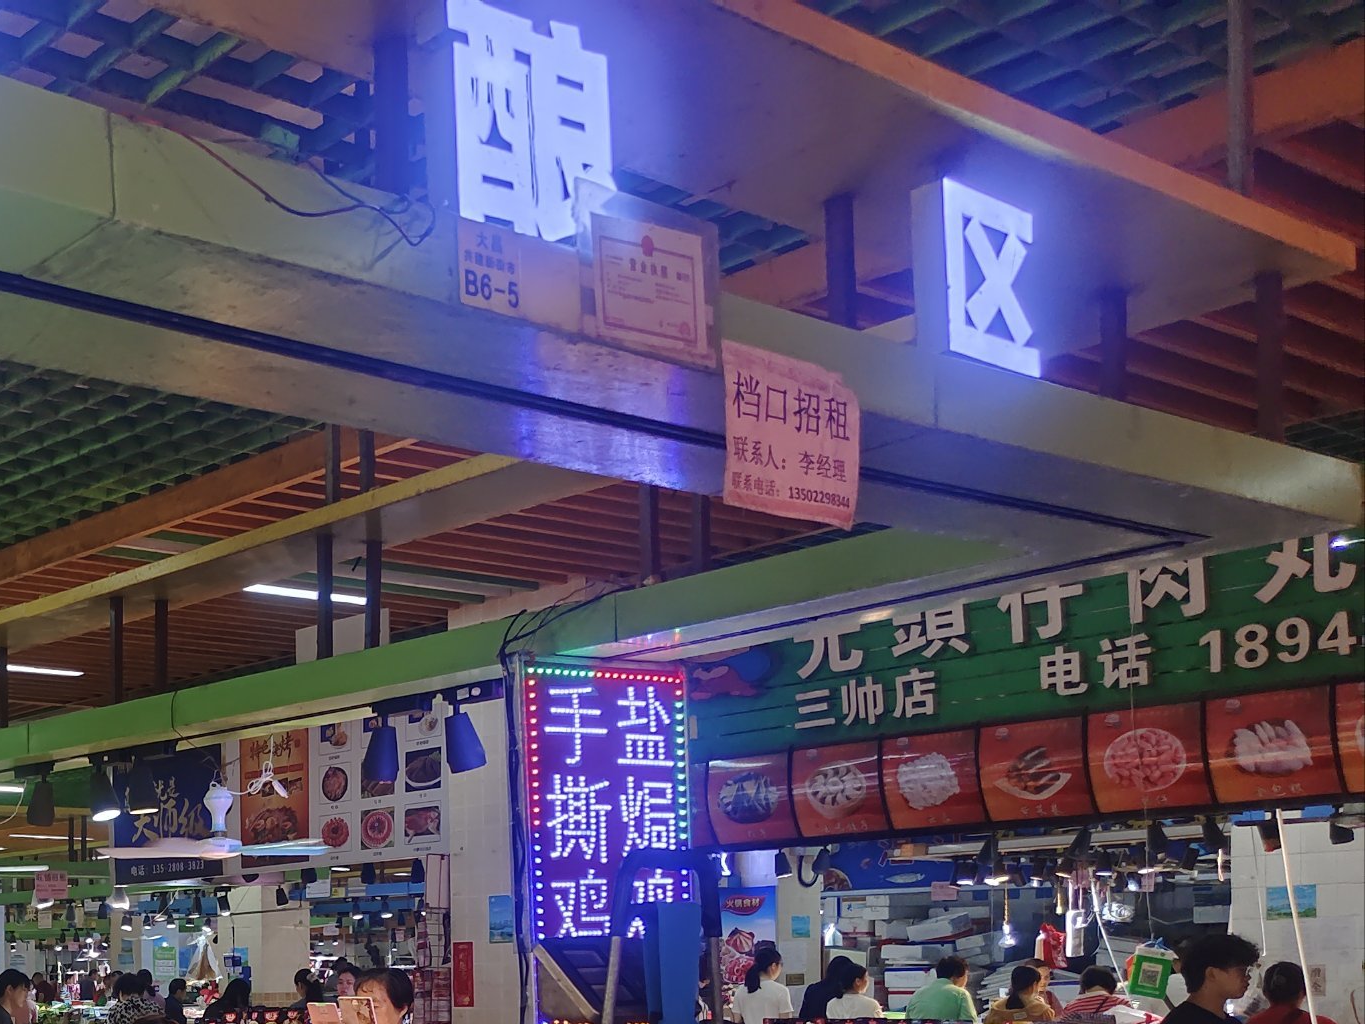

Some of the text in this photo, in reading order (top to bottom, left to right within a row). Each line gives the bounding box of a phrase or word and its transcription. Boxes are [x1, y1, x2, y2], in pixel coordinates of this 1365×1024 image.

[465, 269, 520, 309] B6-5
[942, 177, 1042, 377] 区
[732, 370, 850, 441] 档口招租
[798, 451, 847, 483] 李经理
[1039, 610, 1358, 697] 电话 1894
[794, 668, 937, 730] 三帅店
